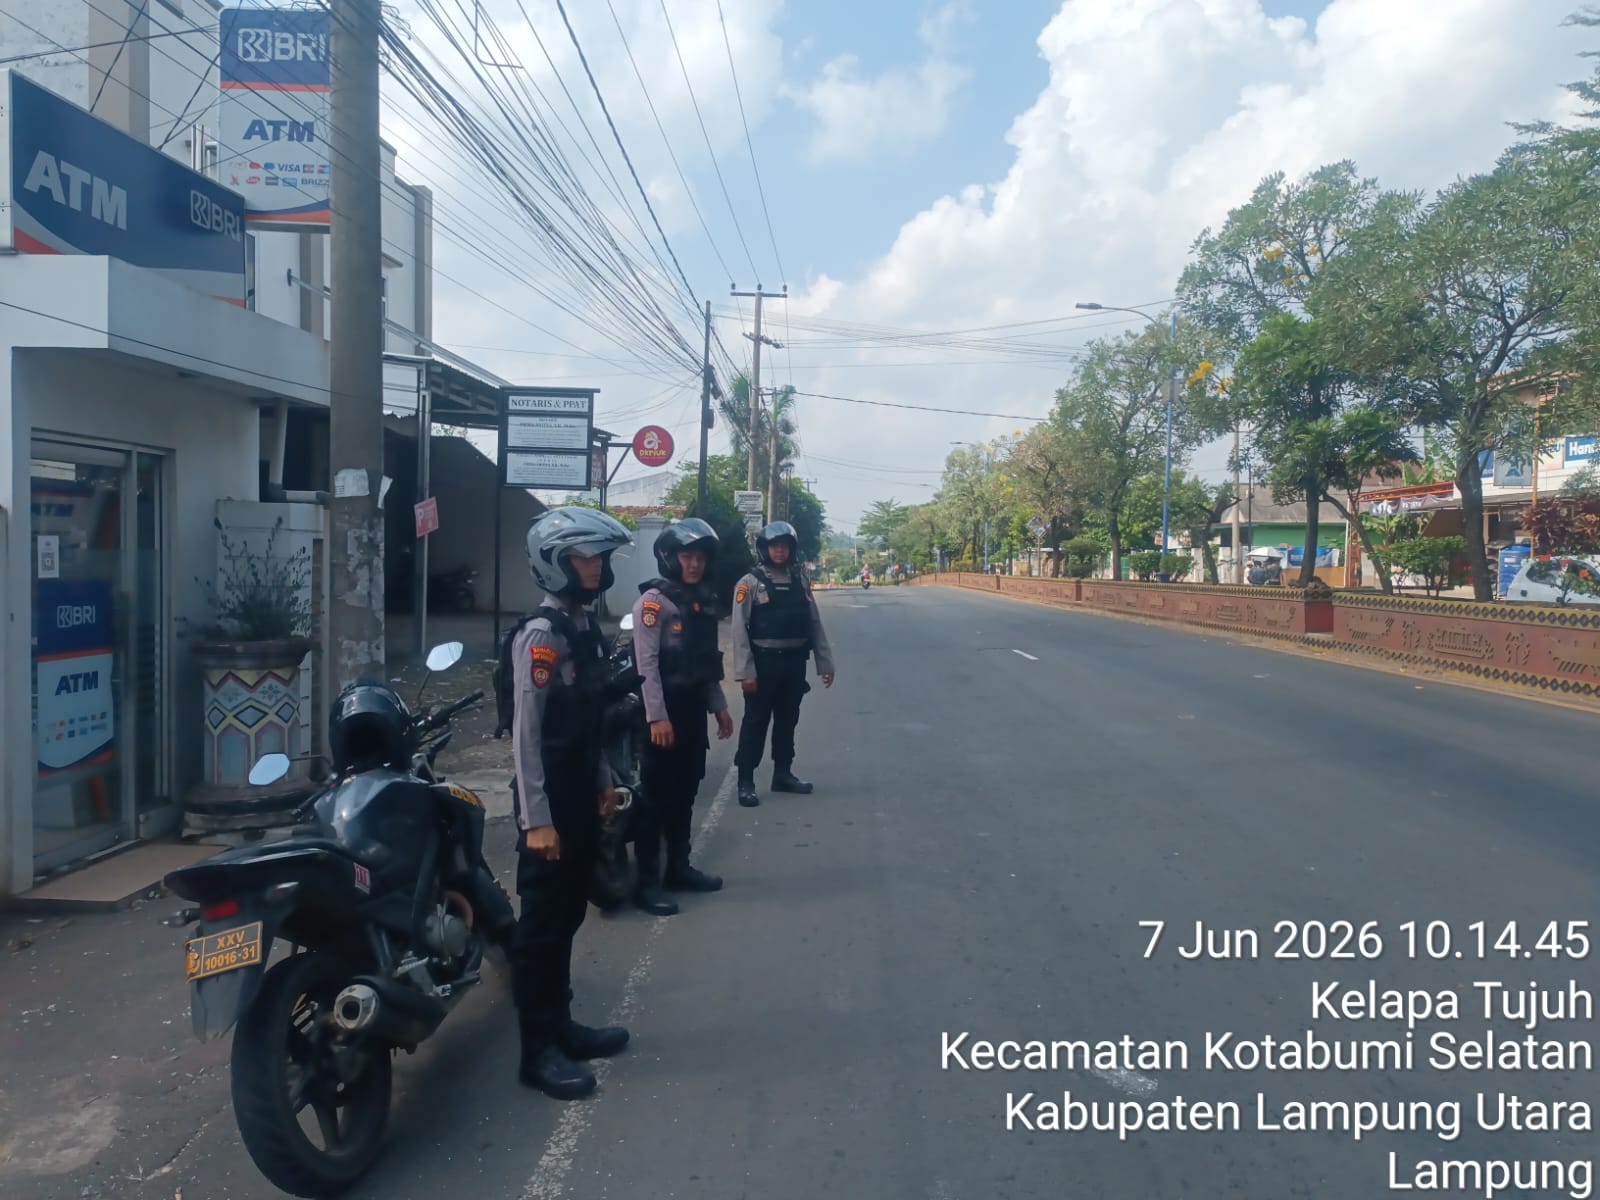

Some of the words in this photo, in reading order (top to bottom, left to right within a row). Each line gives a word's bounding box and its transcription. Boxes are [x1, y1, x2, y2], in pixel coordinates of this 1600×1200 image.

[273, 28, 326, 62] BRI
[243, 119, 315, 143] ATM
[277, 163, 301, 173] VISA
[24, 150, 127, 231] ATM
[212, 204, 241, 242] BRI
[511, 399, 552, 408] NOTARIS
[553, 400, 562, 408] &
[563, 400, 586, 409] PPAT
[72, 605, 96, 626] BRI
[55, 670, 99, 696] ATM
[217, 930, 245, 949] XXV
[205, 945, 255, 970] 10016-31
